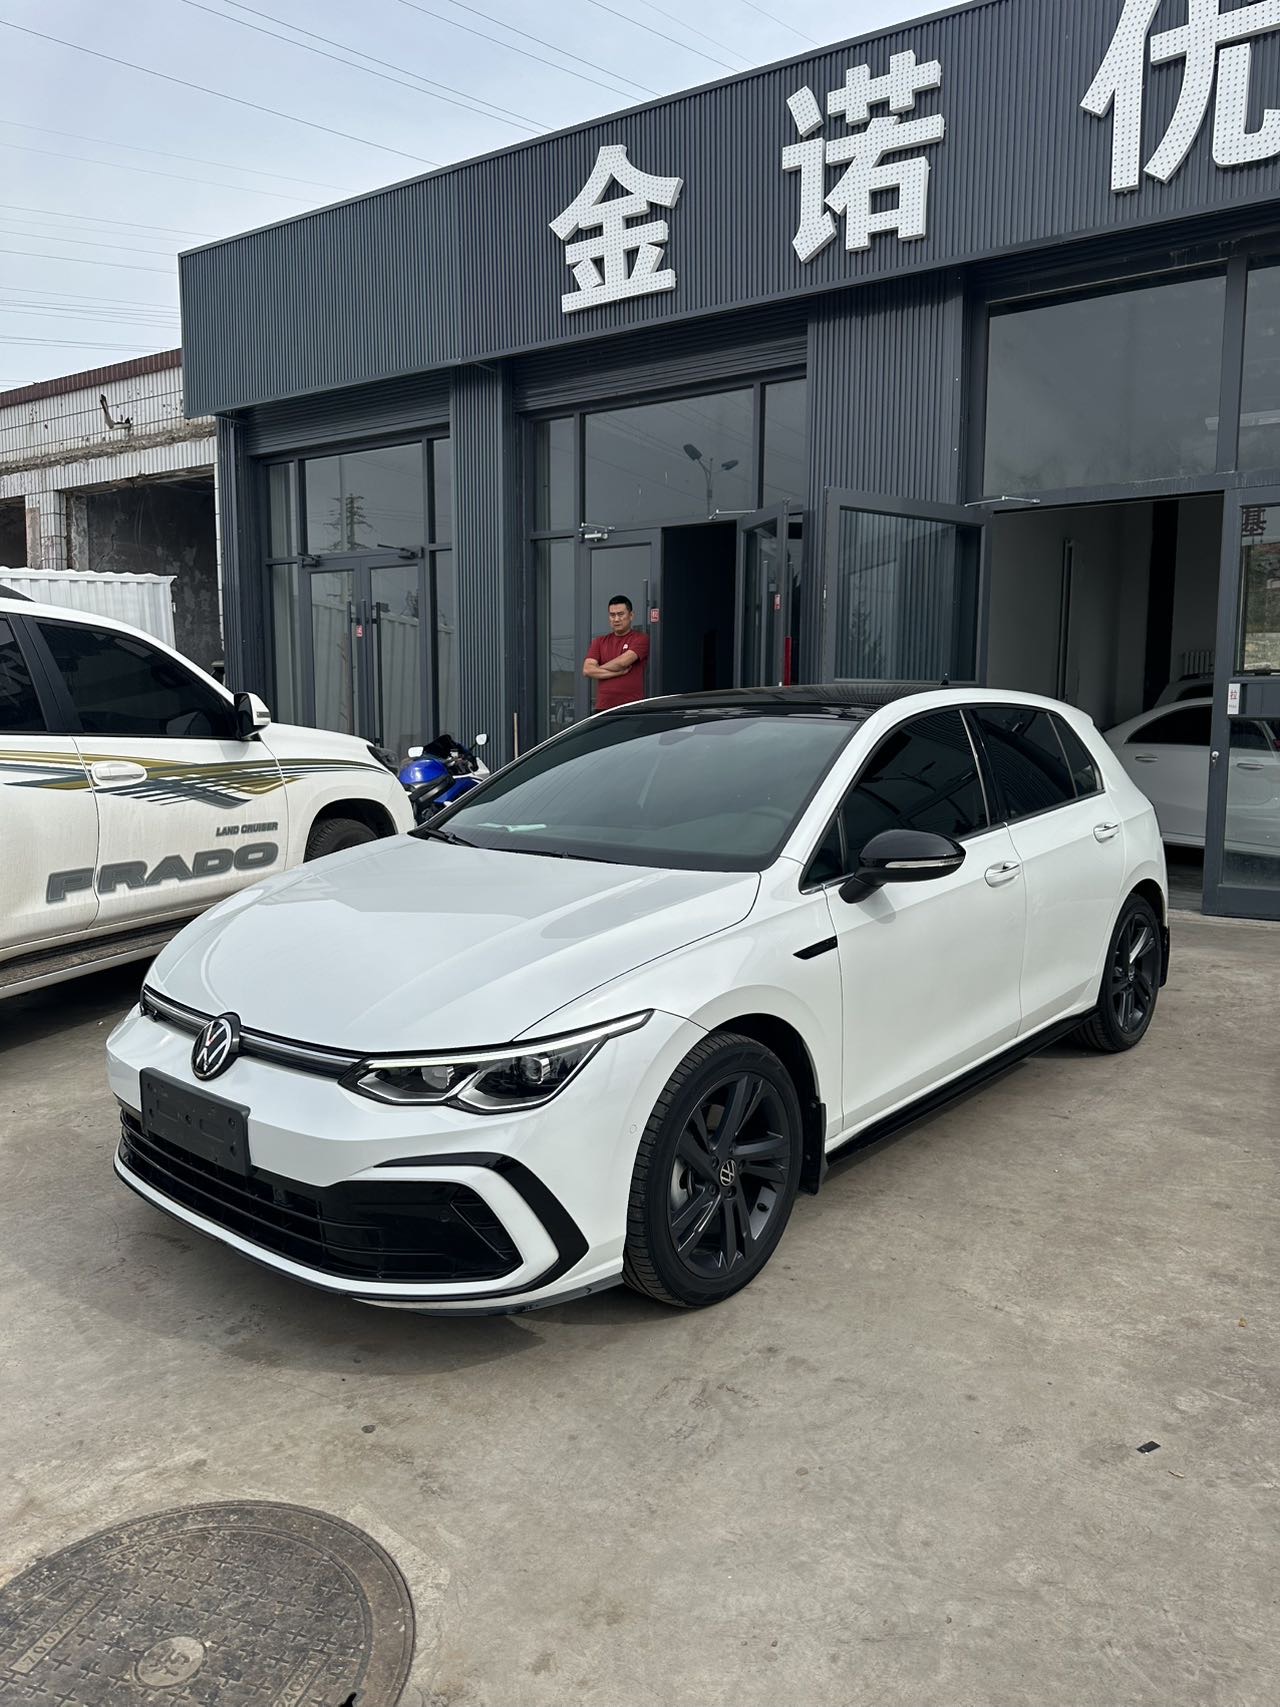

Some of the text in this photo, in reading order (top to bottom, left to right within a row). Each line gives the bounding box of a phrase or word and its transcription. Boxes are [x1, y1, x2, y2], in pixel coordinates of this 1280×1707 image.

[216, 821, 279, 837] LAND CRUISER
[46, 842, 279, 904] PRADO
